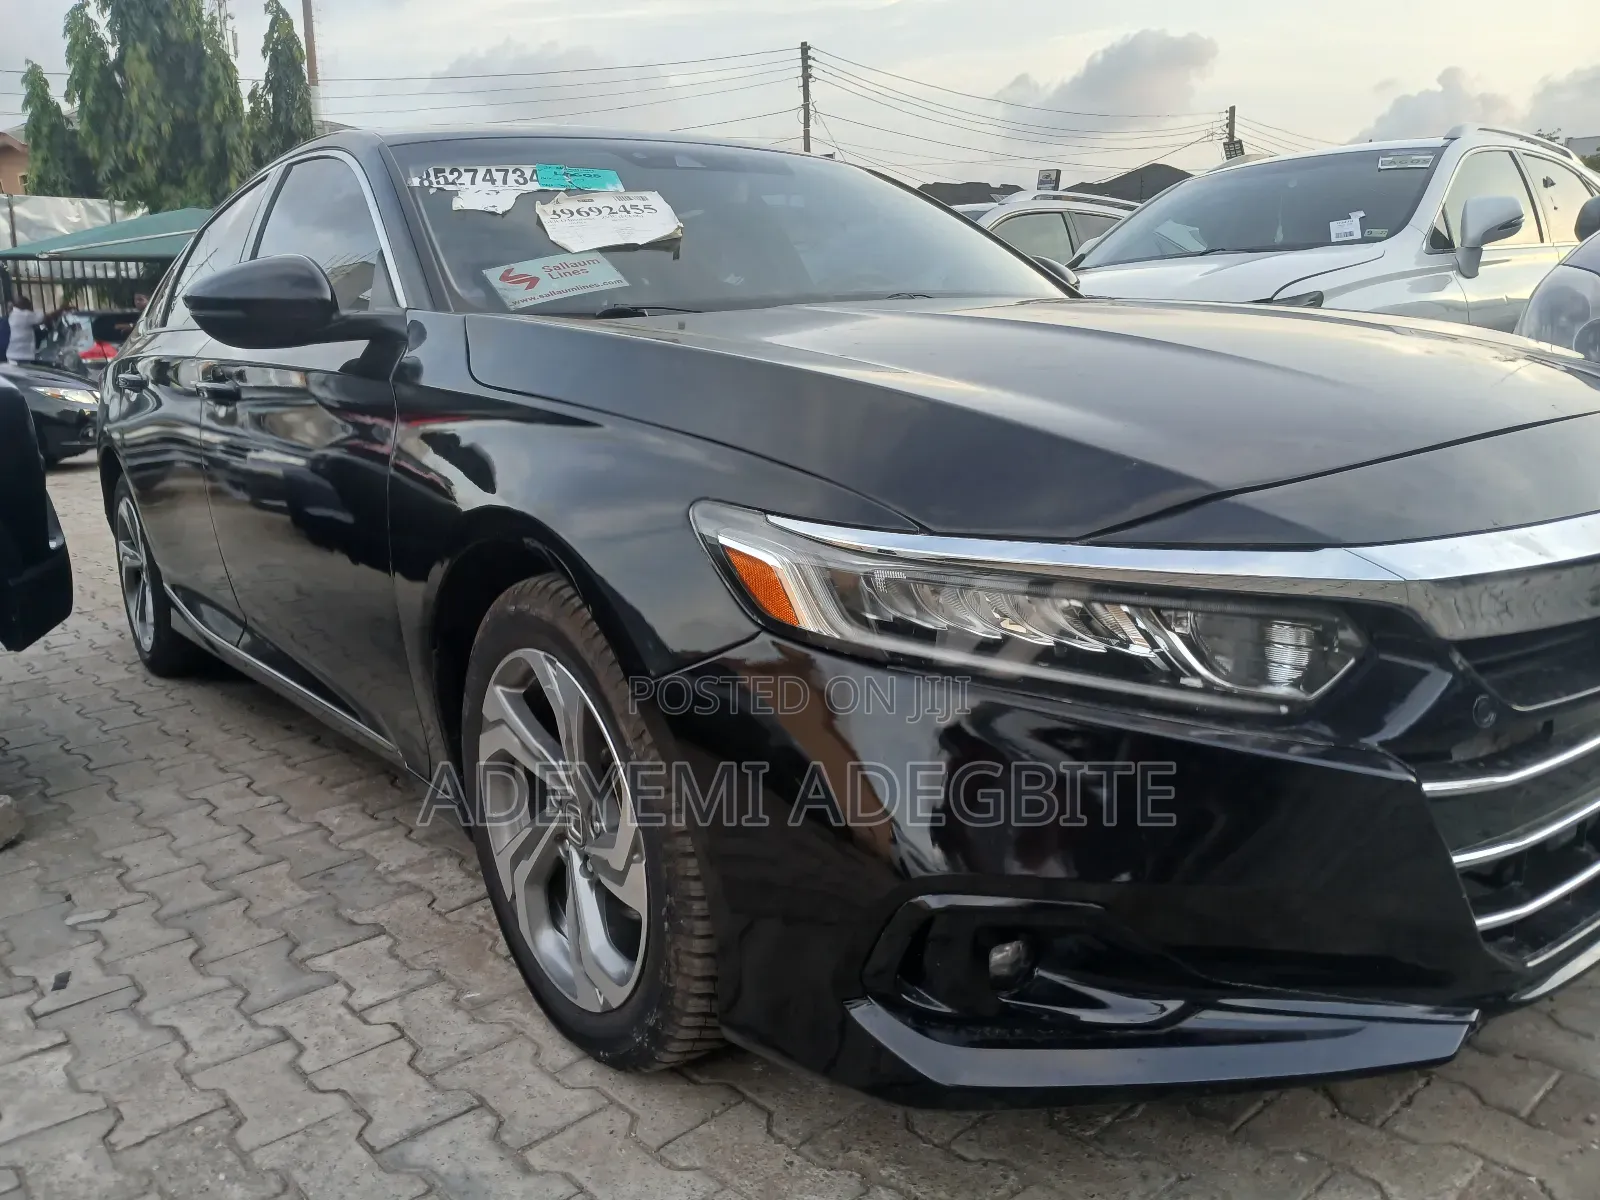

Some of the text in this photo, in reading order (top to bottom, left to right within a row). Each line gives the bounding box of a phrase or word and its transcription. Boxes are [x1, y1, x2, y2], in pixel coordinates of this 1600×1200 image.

[541, 258, 601, 273] Sallaum
[547, 266, 590, 281] Lines
[511, 278, 624, 306] www.sallaumlines.com
